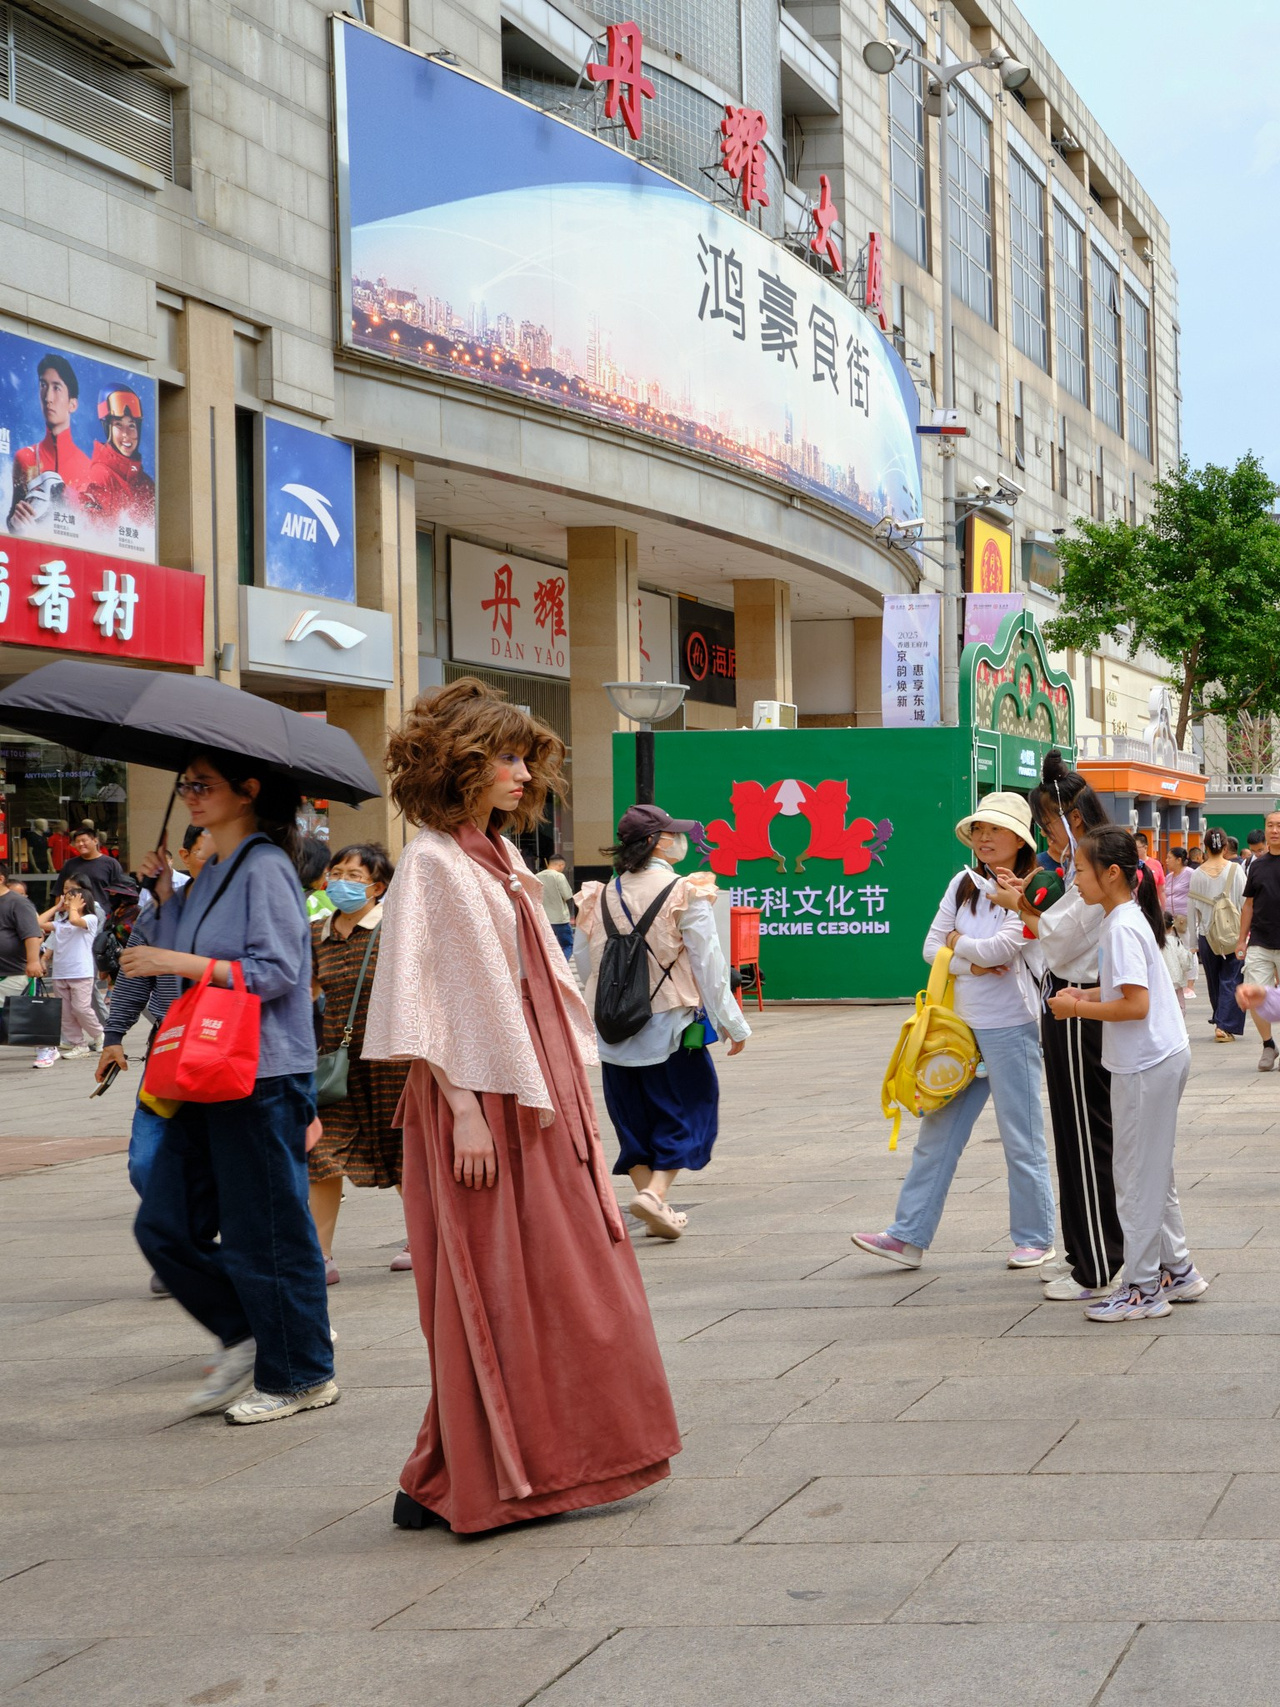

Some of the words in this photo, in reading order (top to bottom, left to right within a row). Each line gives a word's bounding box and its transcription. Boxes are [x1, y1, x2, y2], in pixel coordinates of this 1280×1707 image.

[697, 232, 870, 418] 鸿豪食街
[280, 511, 317, 543] ANTA
[0, 551, 139, 641] 香村
[481, 563, 567, 649] 丹耀
[491, 637, 525, 660] DAN
[534, 646, 565, 667] YAO
[897, 631, 918, 640] 2025
[896, 650, 907, 708] 京韵焕新
[912, 664, 925, 722] 惠享东城
[816, 920, 890, 935] СЕЗОНЫ
